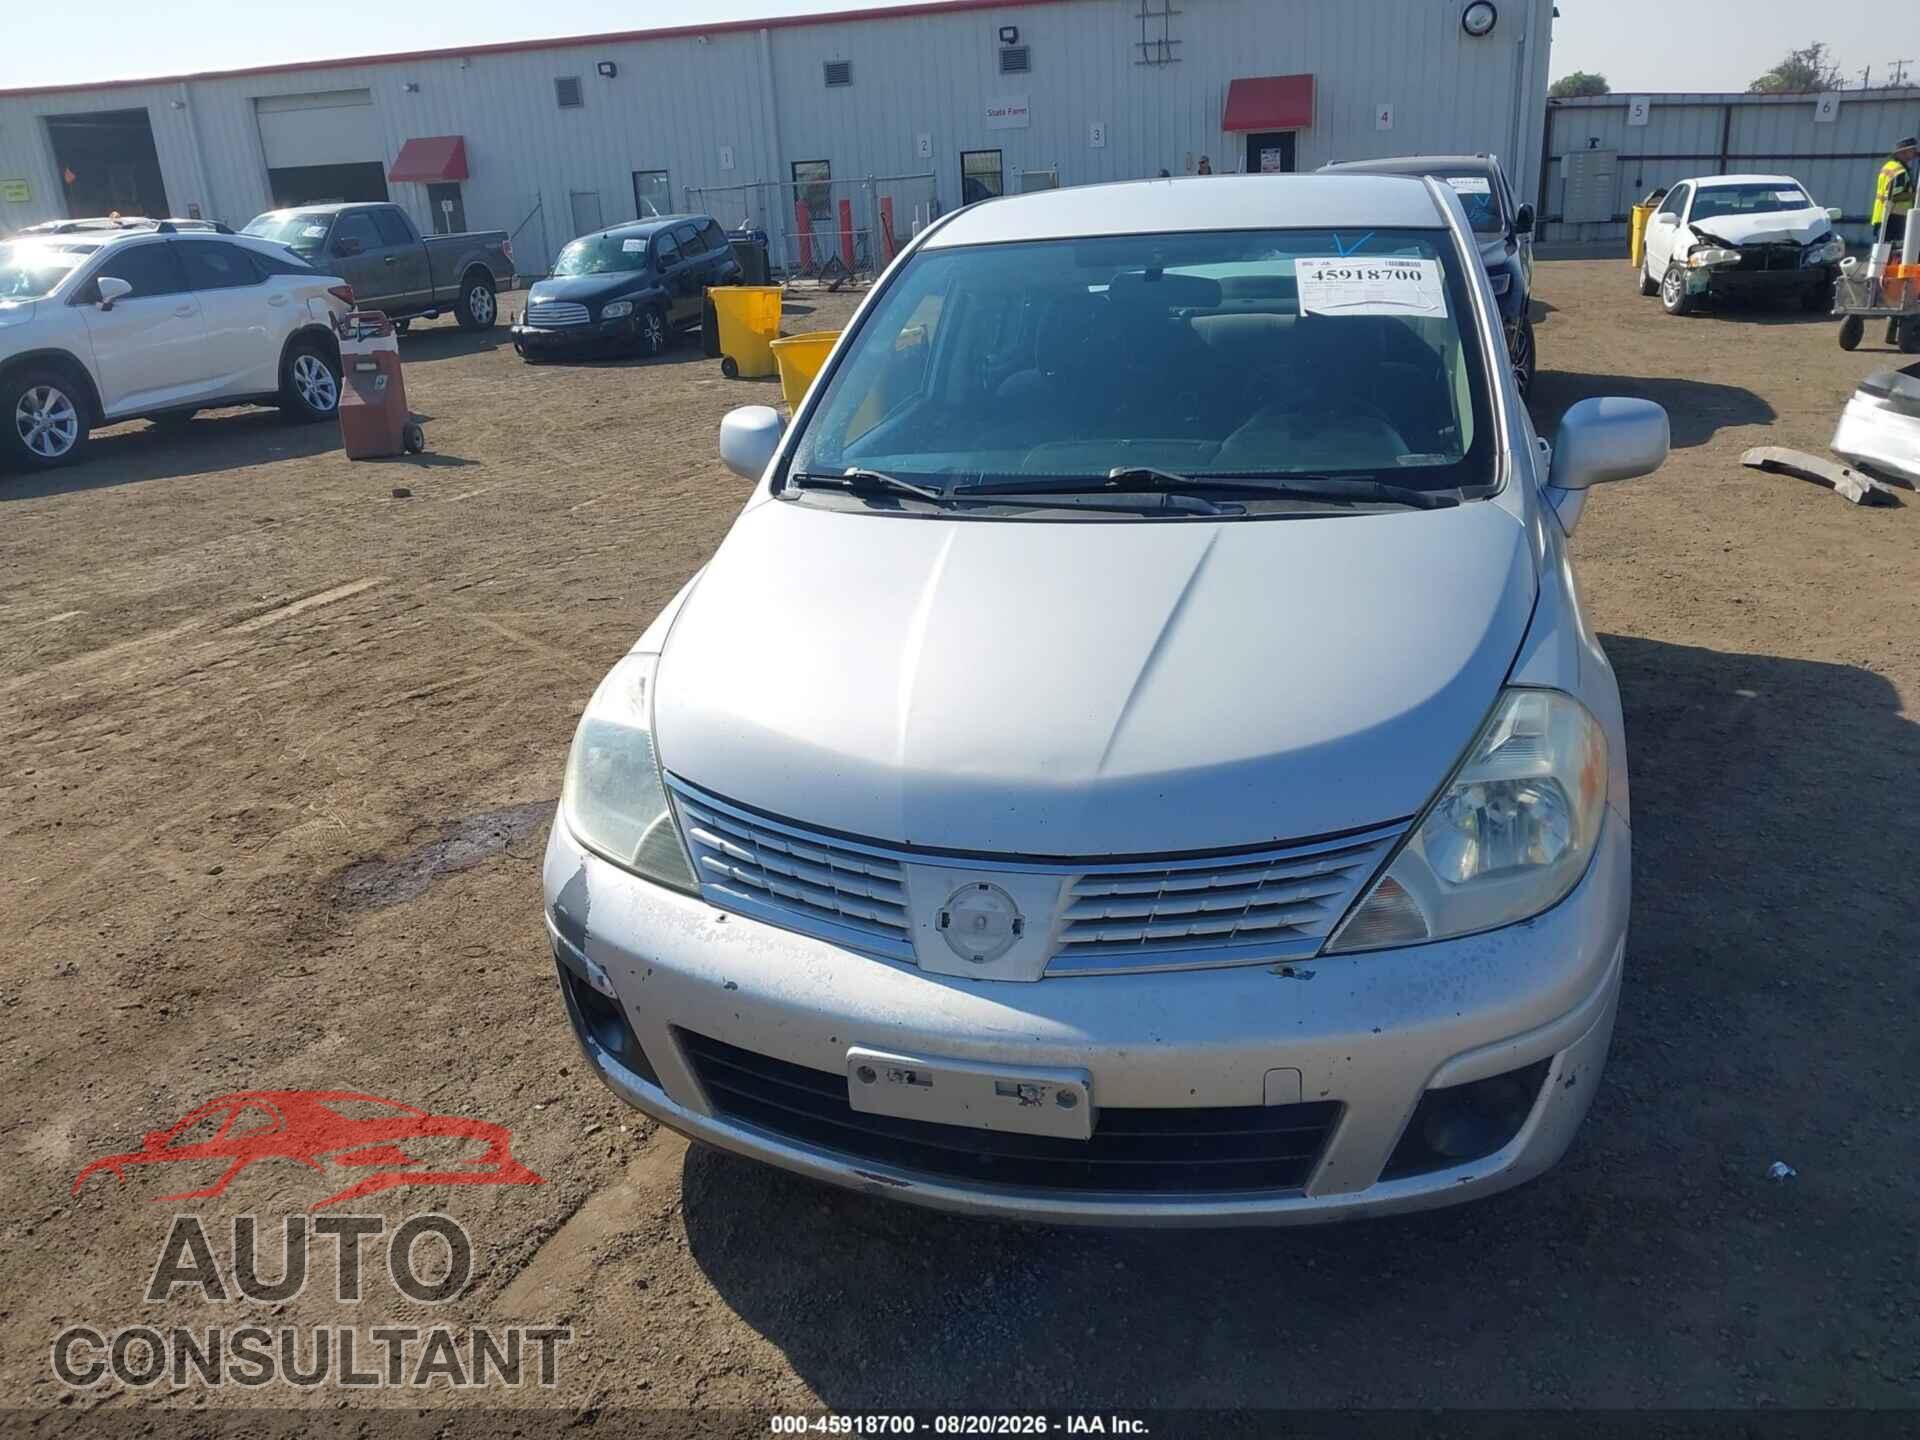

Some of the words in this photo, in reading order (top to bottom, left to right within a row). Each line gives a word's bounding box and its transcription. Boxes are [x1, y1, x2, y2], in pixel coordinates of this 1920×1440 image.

[986, 106, 1006, 117] State
[1007, 106, 1027, 117] Farm
[1634, 104, 1643, 117] 5
[1822, 101, 1831, 113] 6
[1380, 111, 1389, 123] 4
[1094, 129, 1101, 141] 3
[920, 140, 928, 152] 2
[1312, 269, 1422, 281] 45918700
